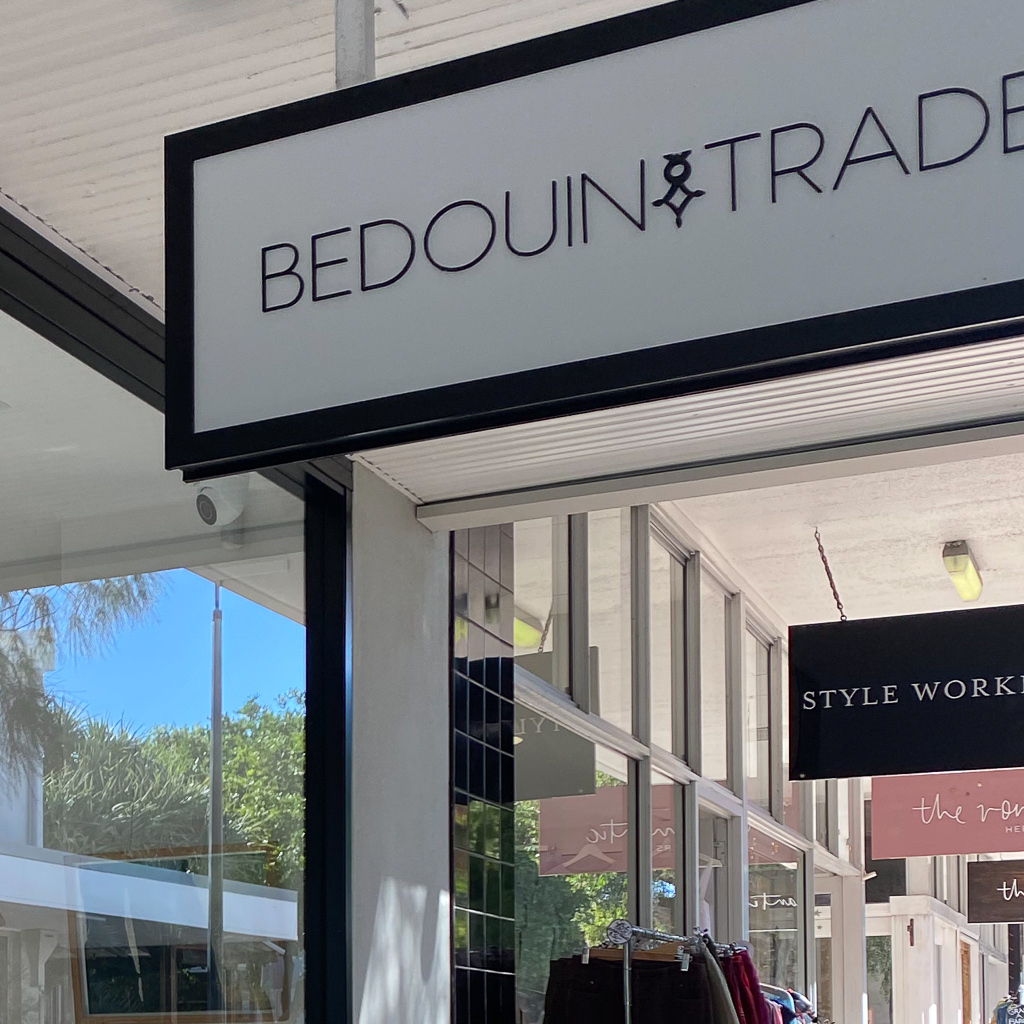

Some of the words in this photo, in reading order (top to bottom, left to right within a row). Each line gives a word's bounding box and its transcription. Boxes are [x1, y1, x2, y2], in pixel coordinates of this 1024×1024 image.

[261, 158, 646, 313] BEDOUIN
[802, 684, 899, 710] STYLE
[911, 675, 1024, 701] WORK
[912, 793, 967, 824] the
